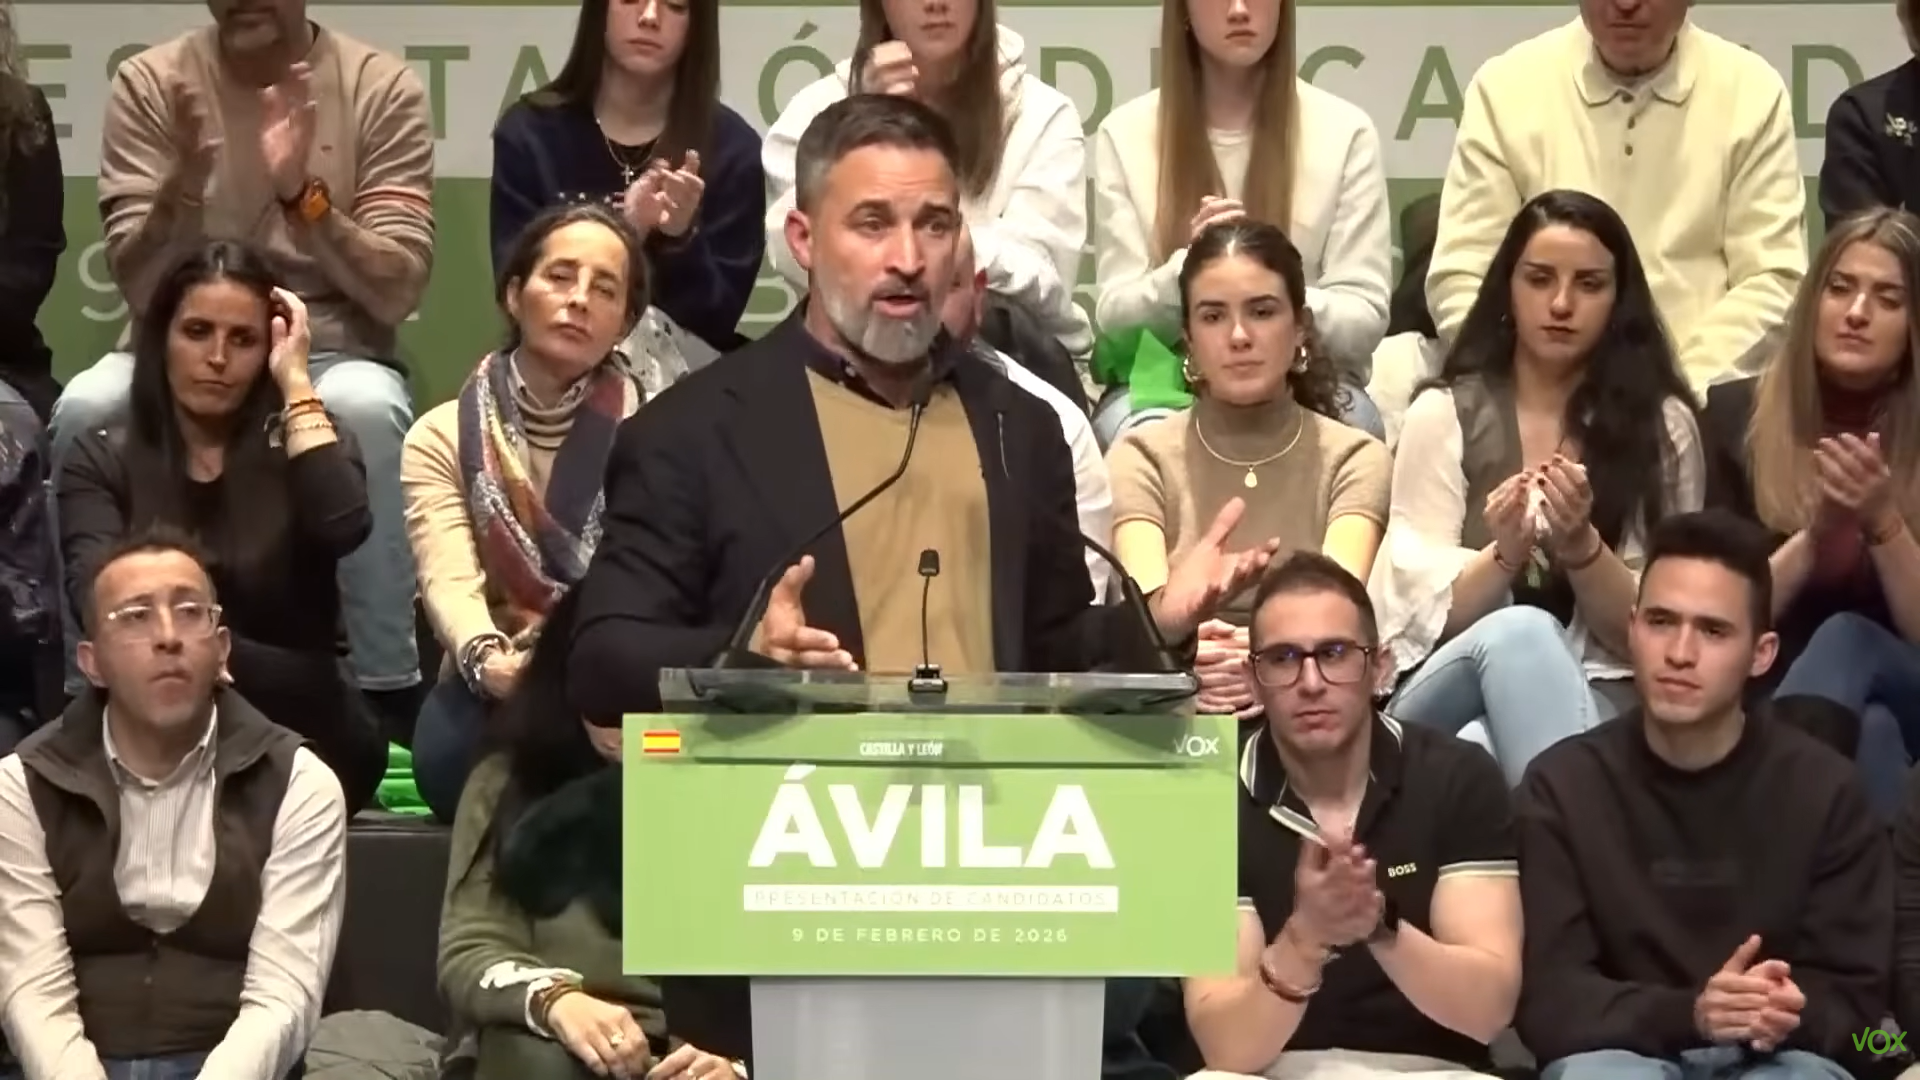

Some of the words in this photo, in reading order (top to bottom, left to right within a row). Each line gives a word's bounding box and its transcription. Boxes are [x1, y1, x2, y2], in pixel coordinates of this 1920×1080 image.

[907, 743, 915, 756] Y
[1172, 733, 1220, 757] VOX
[748, 764, 1116, 869] ÁVILA
[1387, 862, 1417, 878] BOSS
[930, 890, 953, 906] DE
[967, 891, 1107, 906] CANDIDATOS
[791, 928, 804, 943] 9
[816, 928, 845, 943] DE
[856, 928, 961, 943] FEBRERO
[974, 928, 1001, 943] DE
[1015, 928, 1067, 943] 2026
